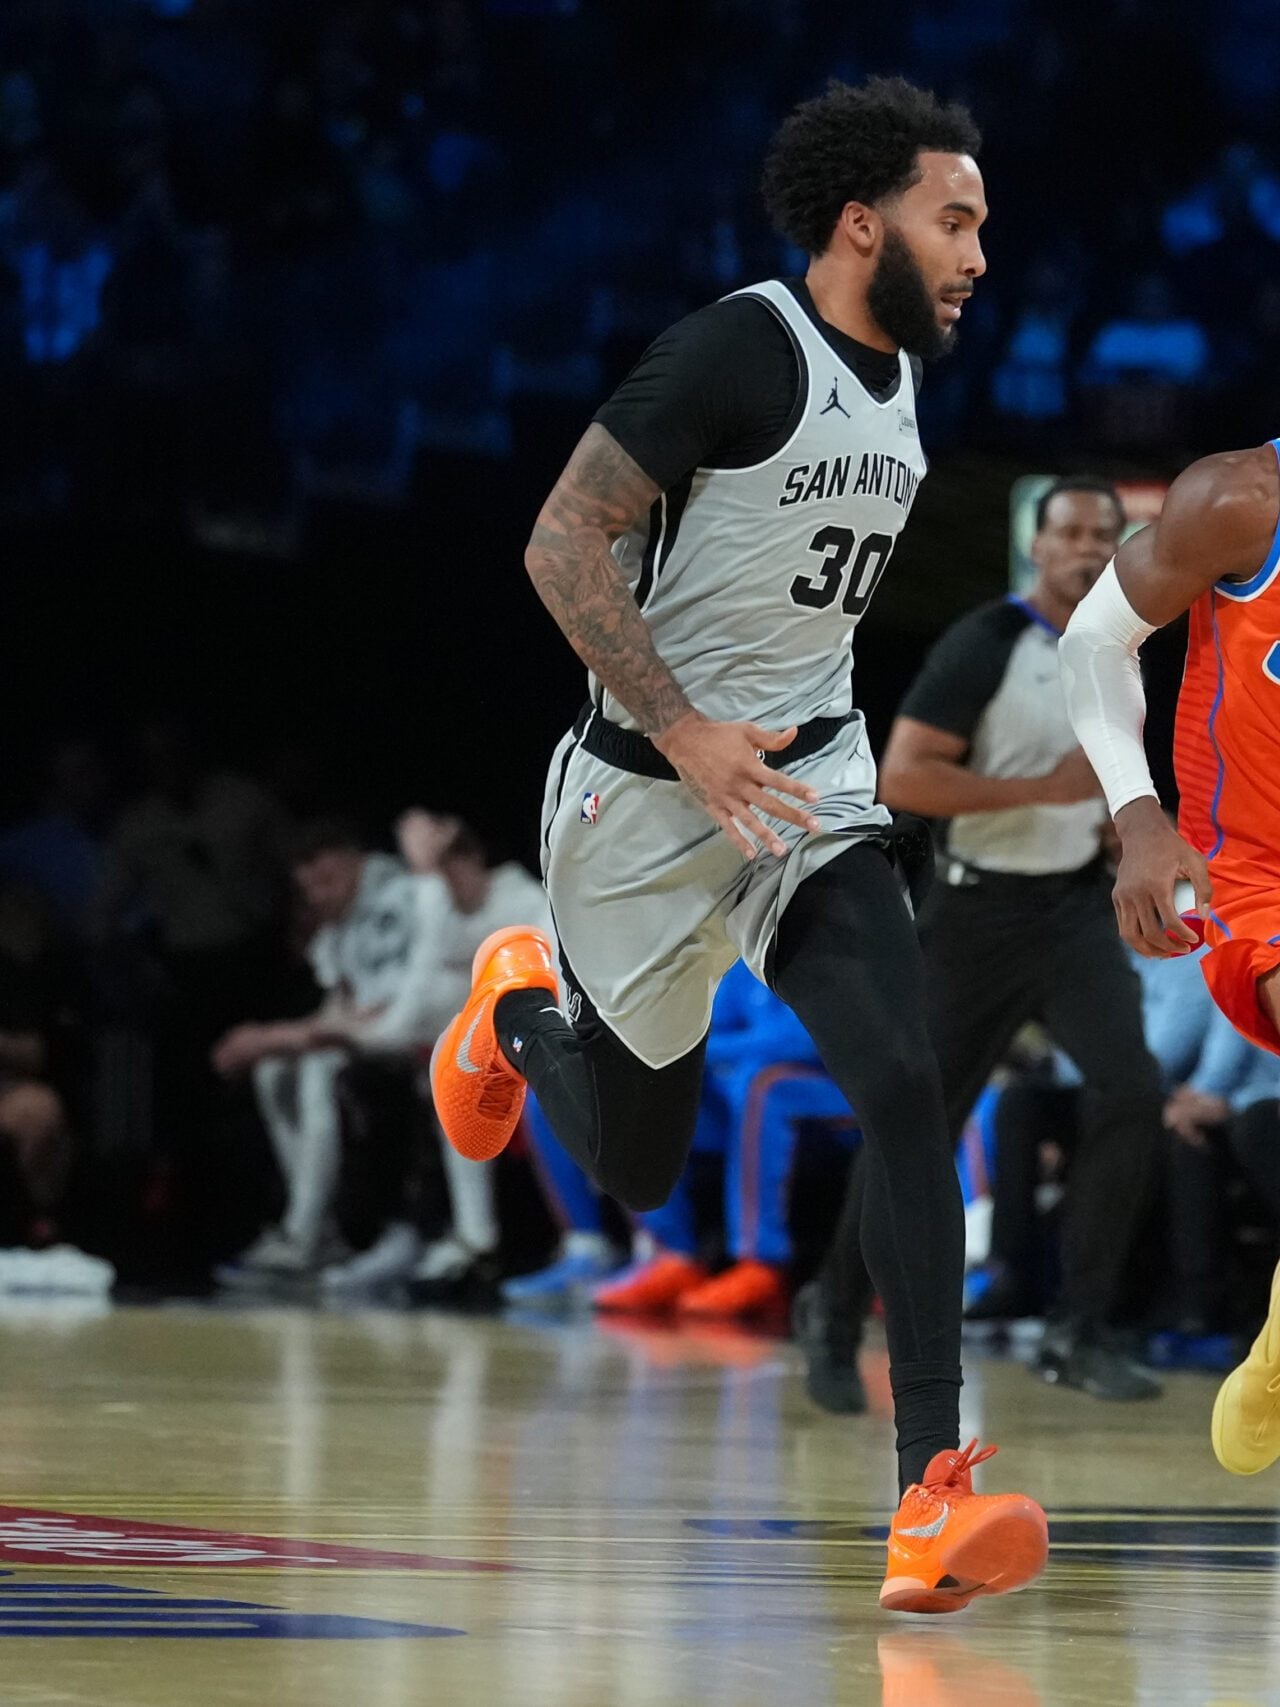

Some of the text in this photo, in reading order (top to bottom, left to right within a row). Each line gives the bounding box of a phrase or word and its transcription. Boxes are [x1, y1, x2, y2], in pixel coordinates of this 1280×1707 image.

[777, 453, 919, 509] SAN ANTON
[788, 524, 896, 617] 30
